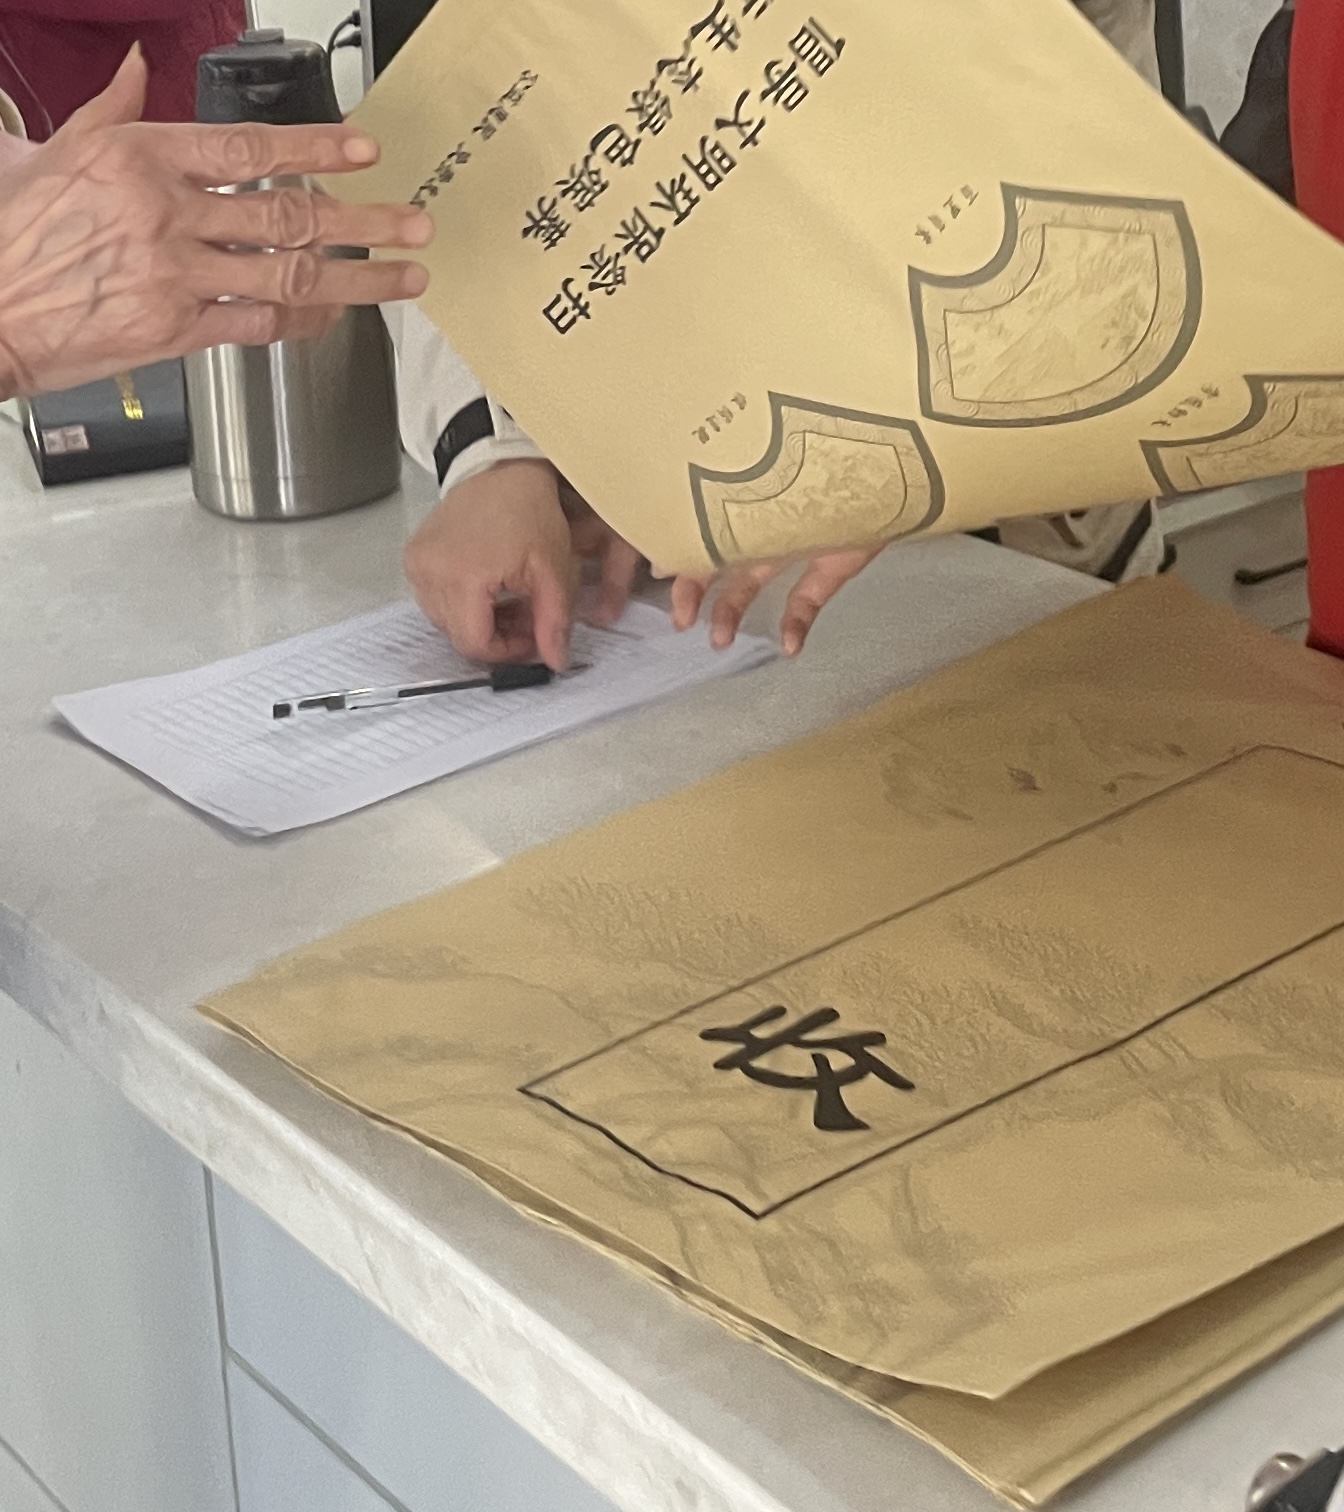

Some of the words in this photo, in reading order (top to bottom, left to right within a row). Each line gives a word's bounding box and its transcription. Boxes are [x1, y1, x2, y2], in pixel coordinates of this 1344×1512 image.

[542, 17, 847, 336] 倡导文明环保祭扫
[699, 1004, 916, 1131] 收
